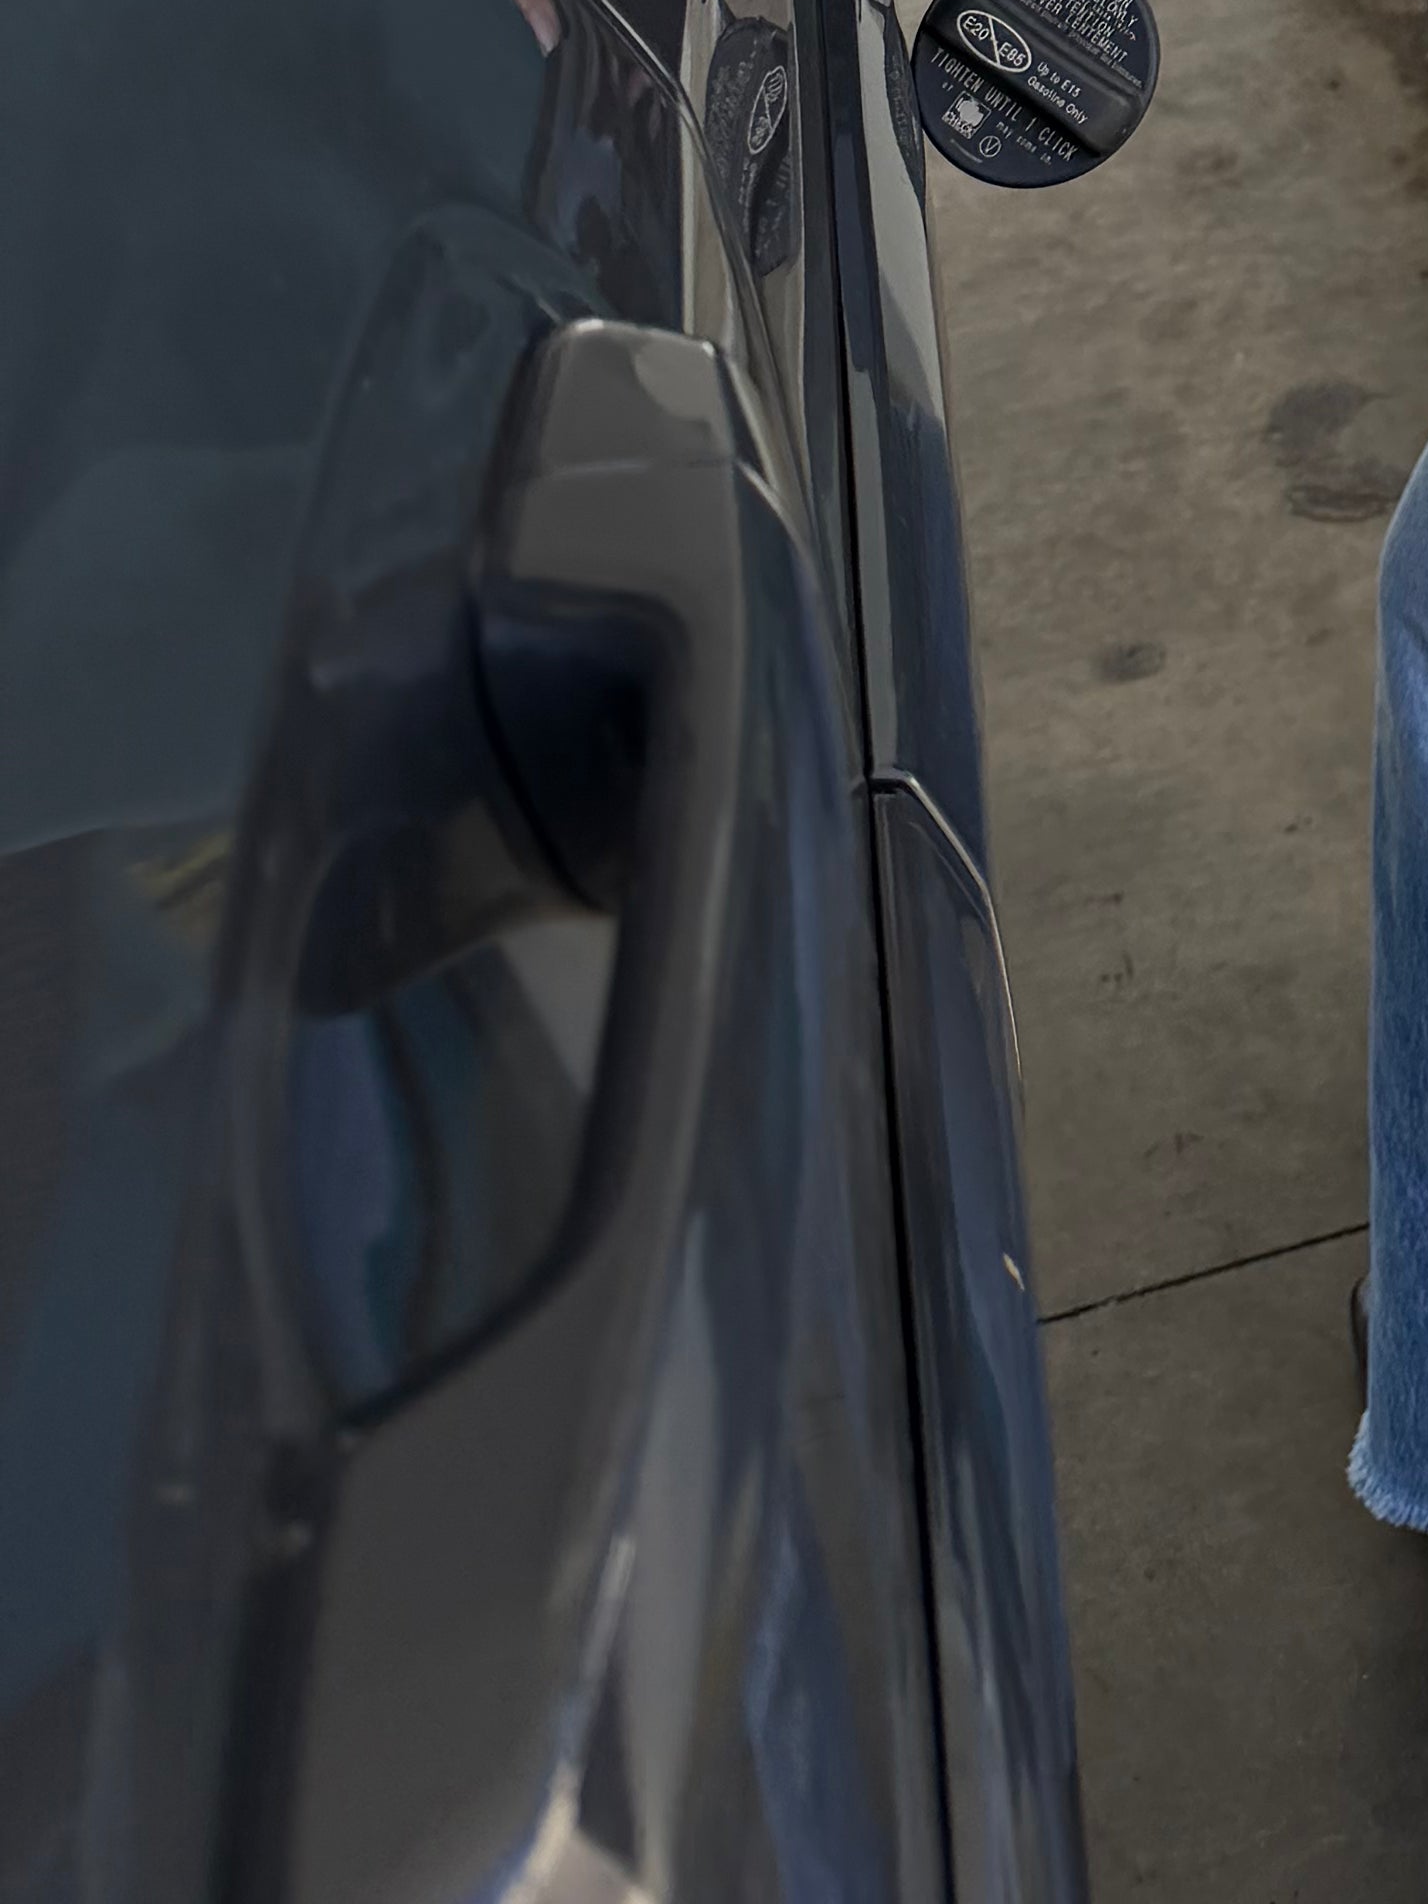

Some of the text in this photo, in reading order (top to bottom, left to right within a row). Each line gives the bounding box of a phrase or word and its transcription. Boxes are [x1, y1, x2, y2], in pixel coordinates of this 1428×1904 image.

[962, 16, 989, 40] E20
[1065, 14, 1128, 62] LENTEMENT
[999, 42, 1026, 66] E85
[1027, 76, 1088, 124] Gasoline Only
[1037, 61, 1081, 98] Up to E15
[931, 48, 984, 93] TIGHTEN
[985, 86, 1023, 122] UNTIL
[1038, 127, 1078, 161] CLICK
